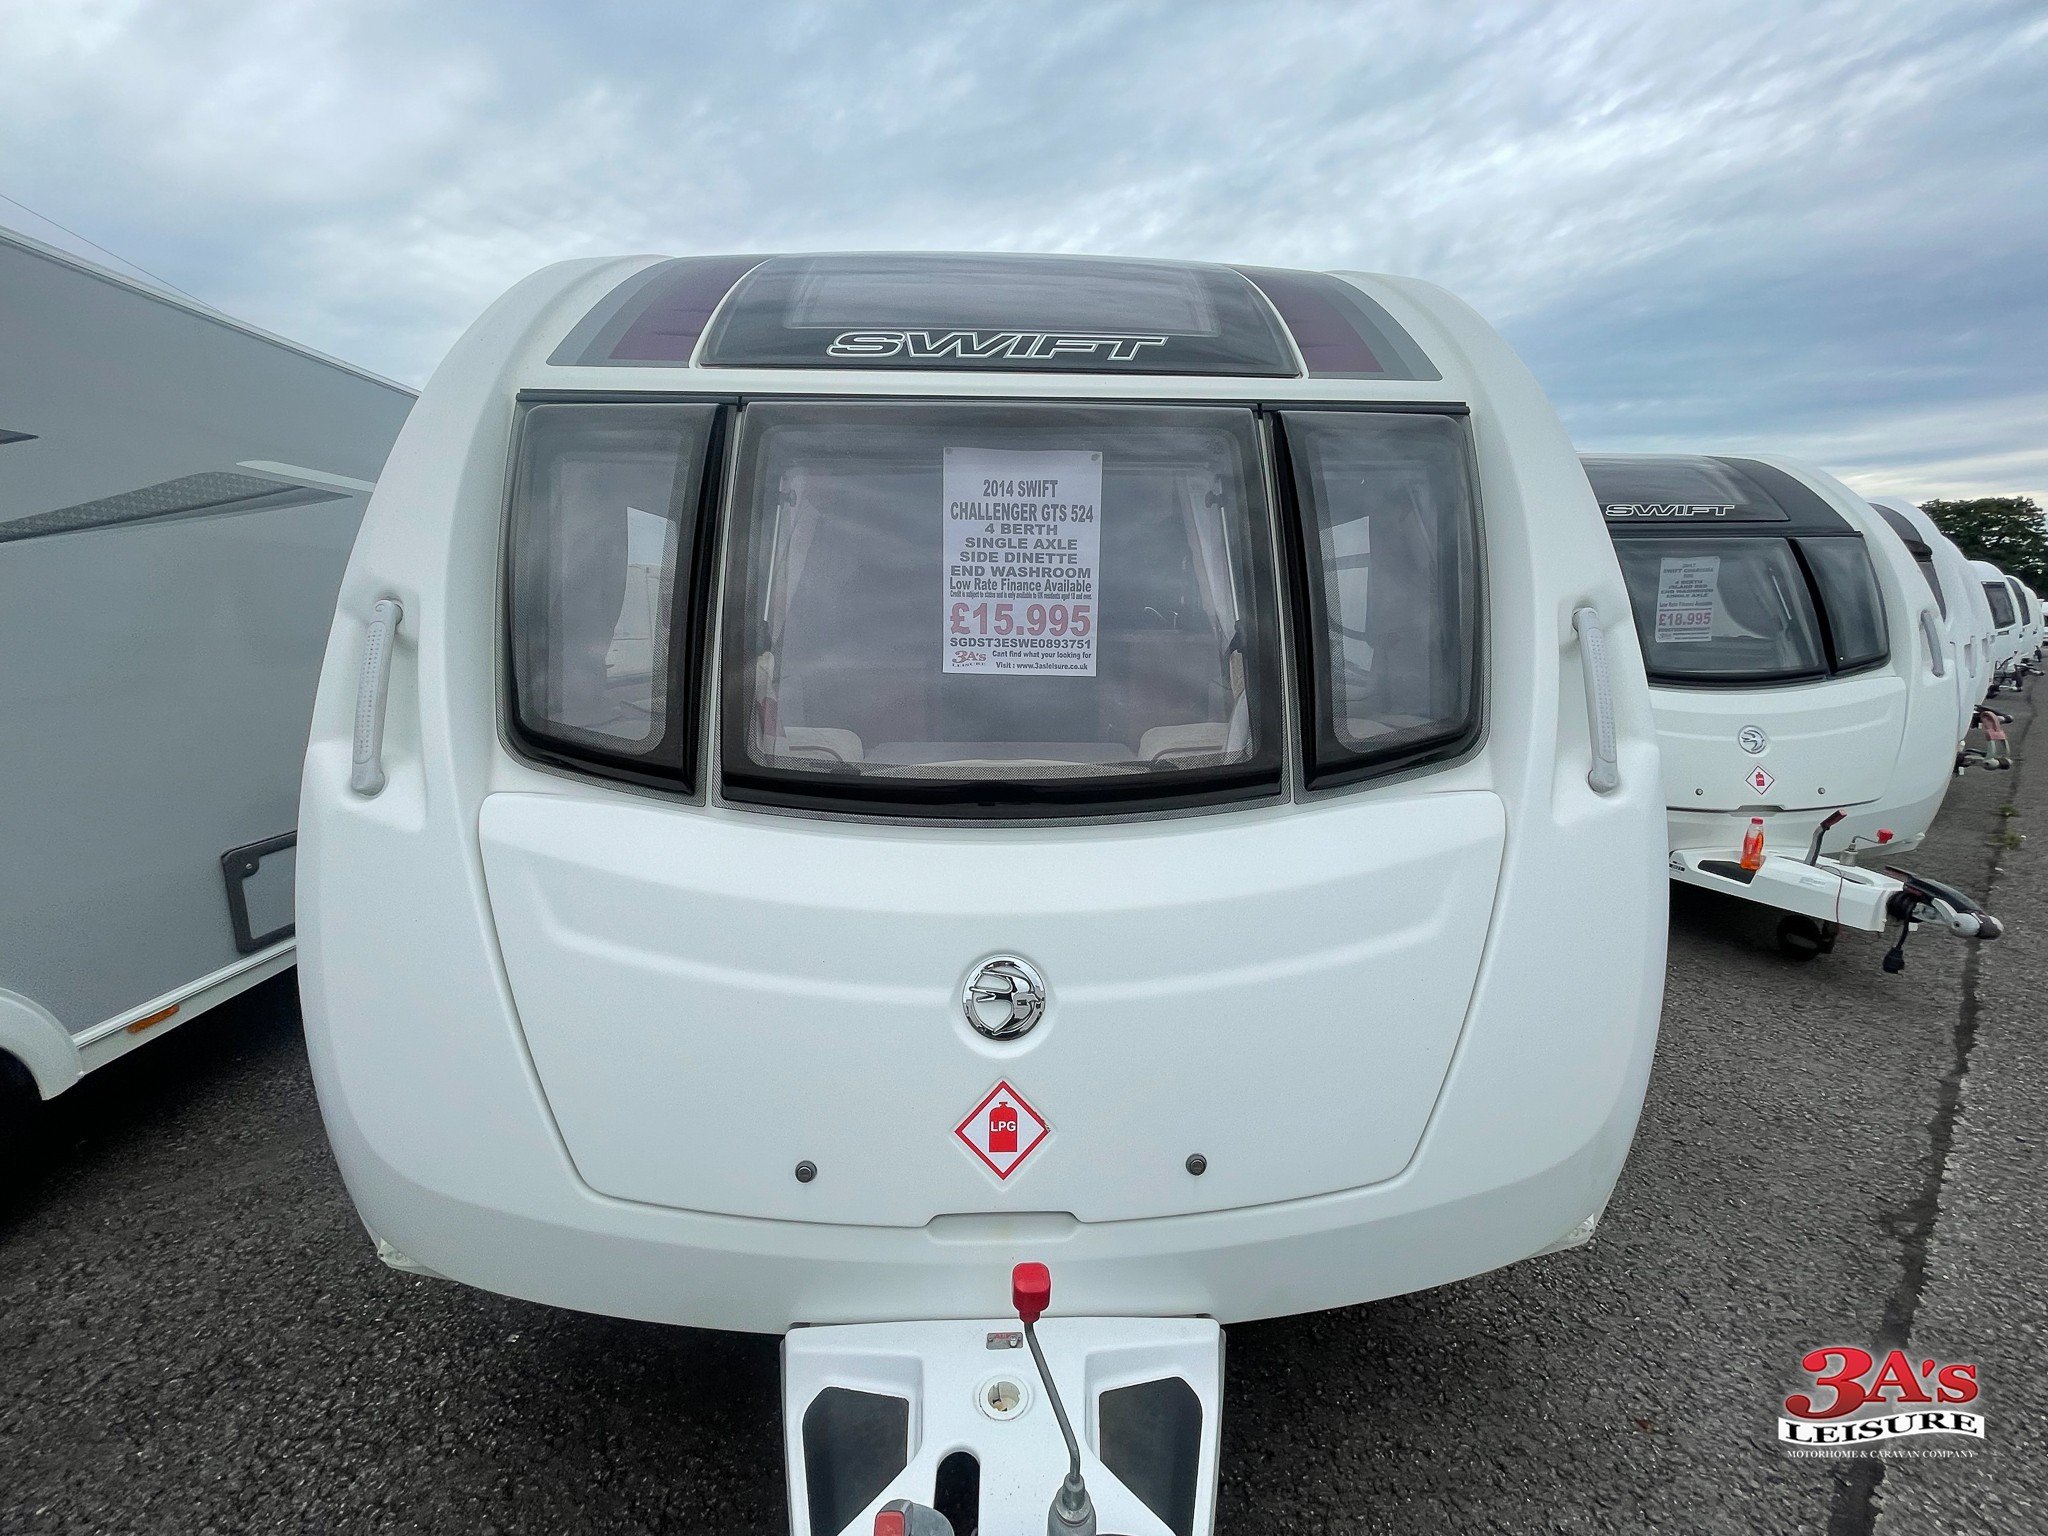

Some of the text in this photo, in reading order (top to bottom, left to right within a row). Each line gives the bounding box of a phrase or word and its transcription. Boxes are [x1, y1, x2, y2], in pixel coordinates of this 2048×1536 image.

[826, 331, 1169, 361] SWIFT
[983, 479, 1058, 498] 2014 SWIFT
[950, 502, 1093, 523] CHALLENGER GTS 524
[1605, 504, 1735, 516] SWIFT
[984, 523, 1058, 535] 4 BERTH
[965, 537, 1078, 550] SINGLE AXLE
[960, 551, 1078, 564] SIDE DINETTE
[950, 565, 1091, 579] END WASHROOM
[950, 577, 1092, 593] Low Rate Finance Available
[950, 602, 1091, 637] £15.995
[1658, 612, 1712, 626] £18.995
[950, 637, 1091, 649] SGDST3ESWE0893751
[952, 650, 987, 664] 3A's
[992, 650, 1008, 658] Cant
[1009, 650, 1022, 658] find
[1041, 652, 1055, 660] your
[1057, 651, 1080, 660] looking
[1082, 651, 1092, 659] for
[995, 661, 1011, 669] Visit
[1017, 662, 1088, 670] www.3asleisure.co.uk
[990, 1121, 1017, 1132] LPG
